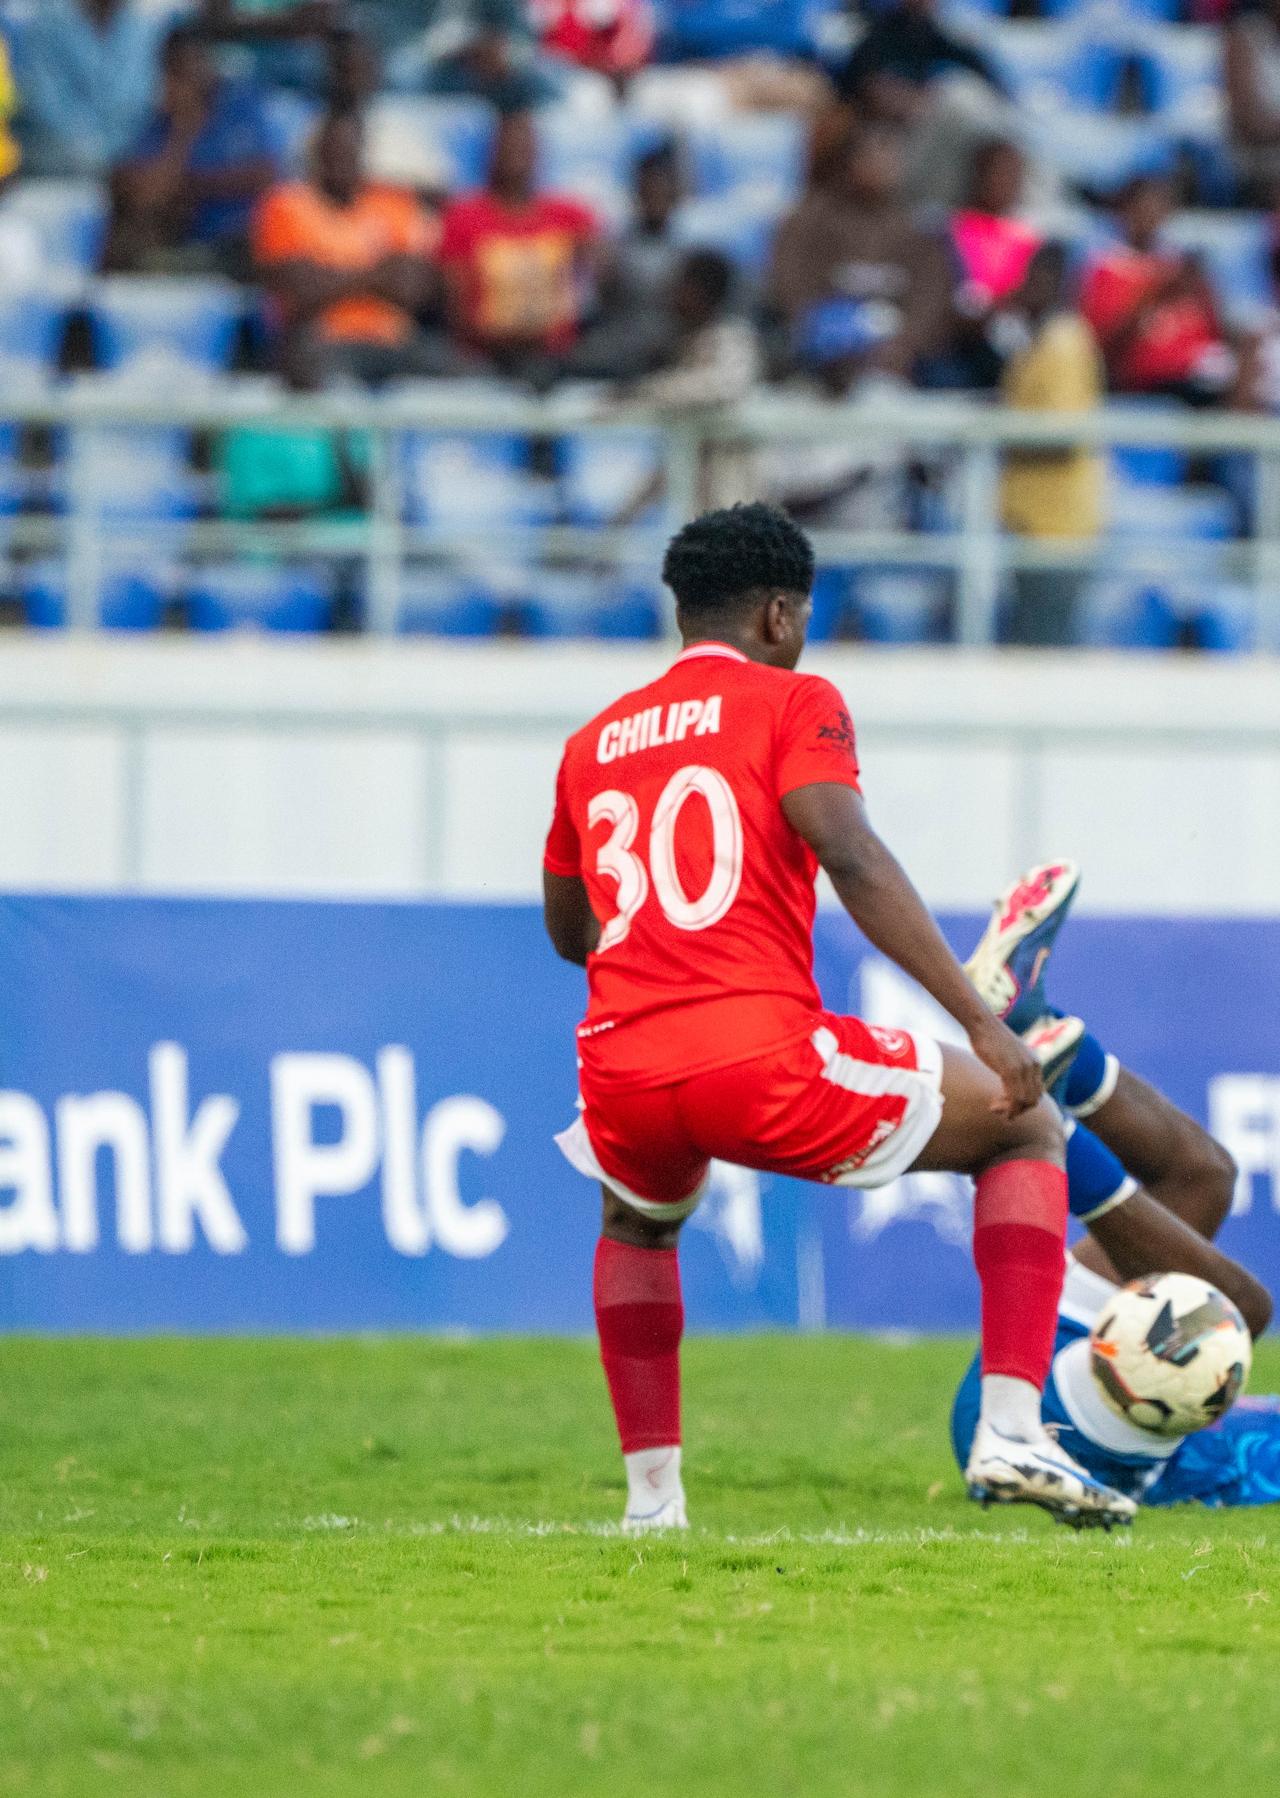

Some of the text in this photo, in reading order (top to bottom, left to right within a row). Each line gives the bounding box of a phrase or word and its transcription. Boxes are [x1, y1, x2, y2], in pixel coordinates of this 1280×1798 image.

[596, 694, 722, 764] CHILIPA
[587, 765, 744, 955] 30
[269, 1043, 509, 1259] Plc
